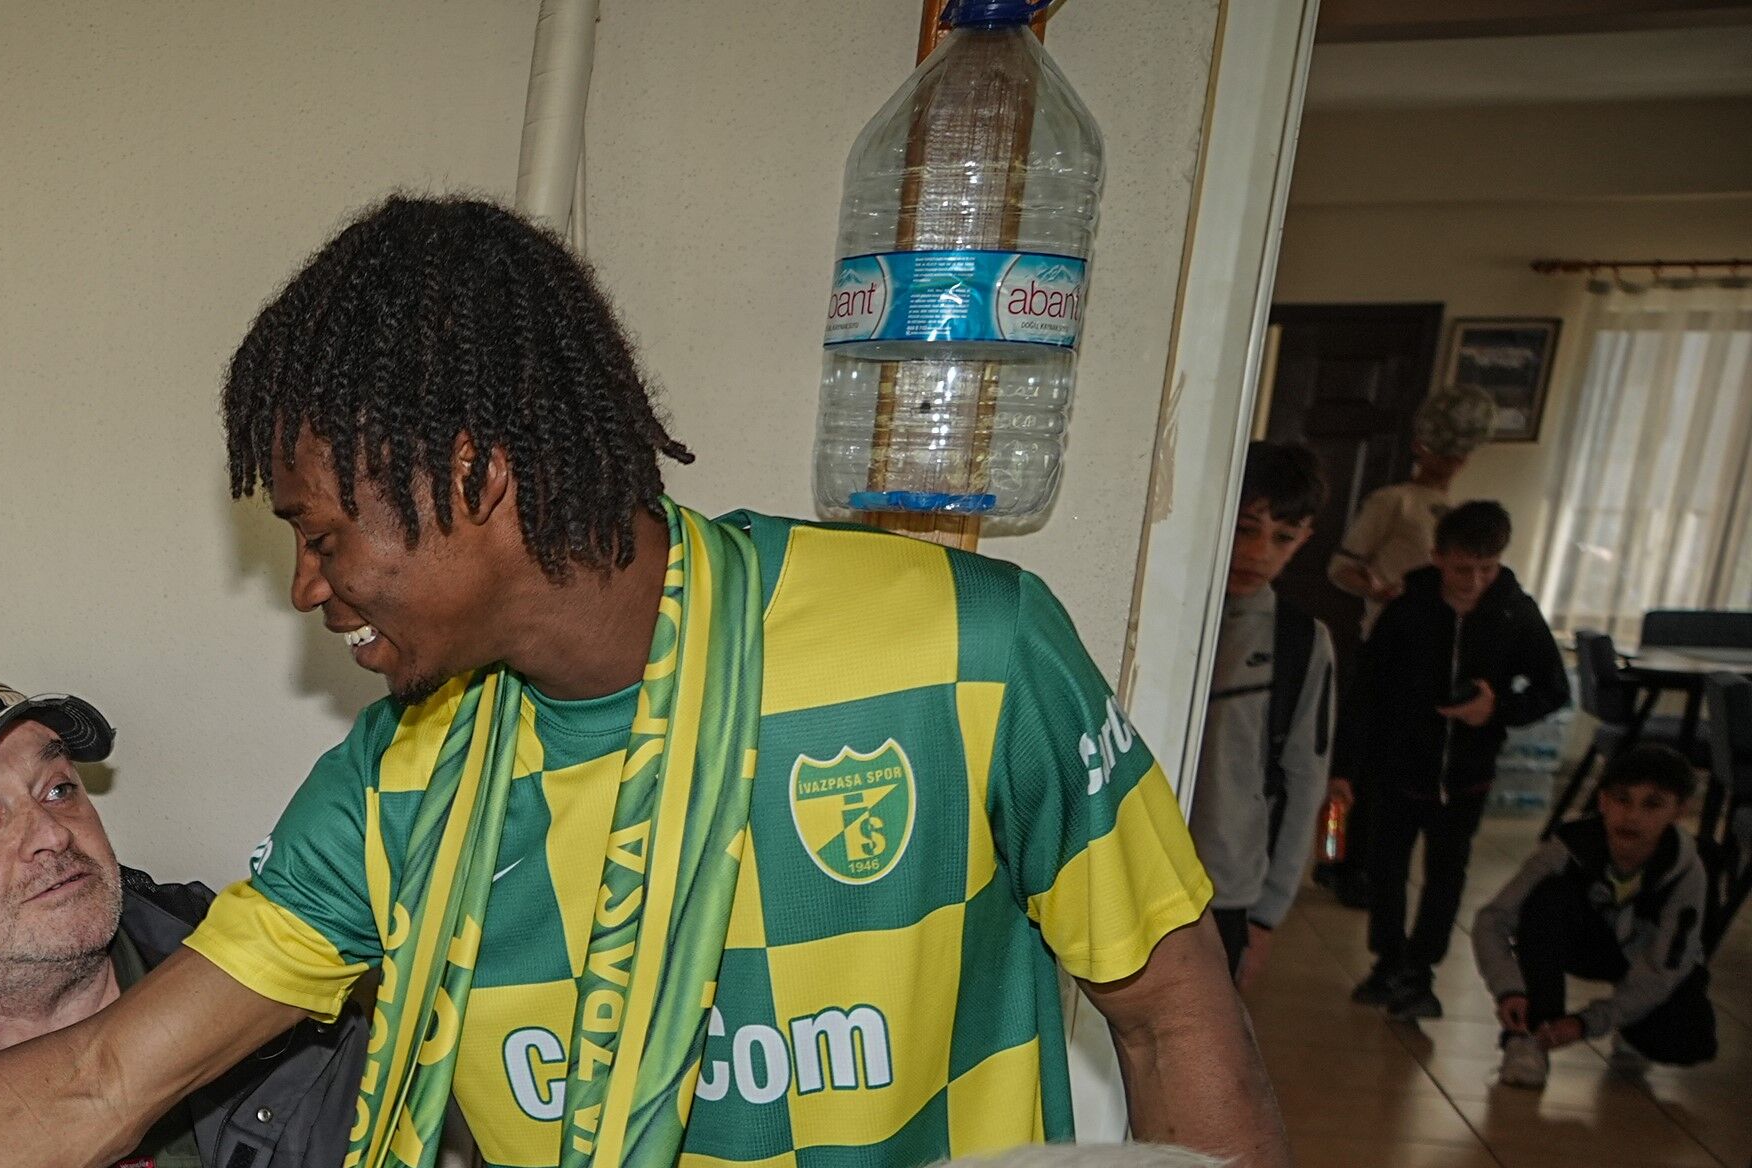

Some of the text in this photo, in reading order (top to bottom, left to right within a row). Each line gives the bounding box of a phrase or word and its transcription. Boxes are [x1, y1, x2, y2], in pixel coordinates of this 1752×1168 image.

[1008, 280, 1081, 320] abant
[866, 766, 903, 784] SPOR
[848, 859, 880, 873] 1946
